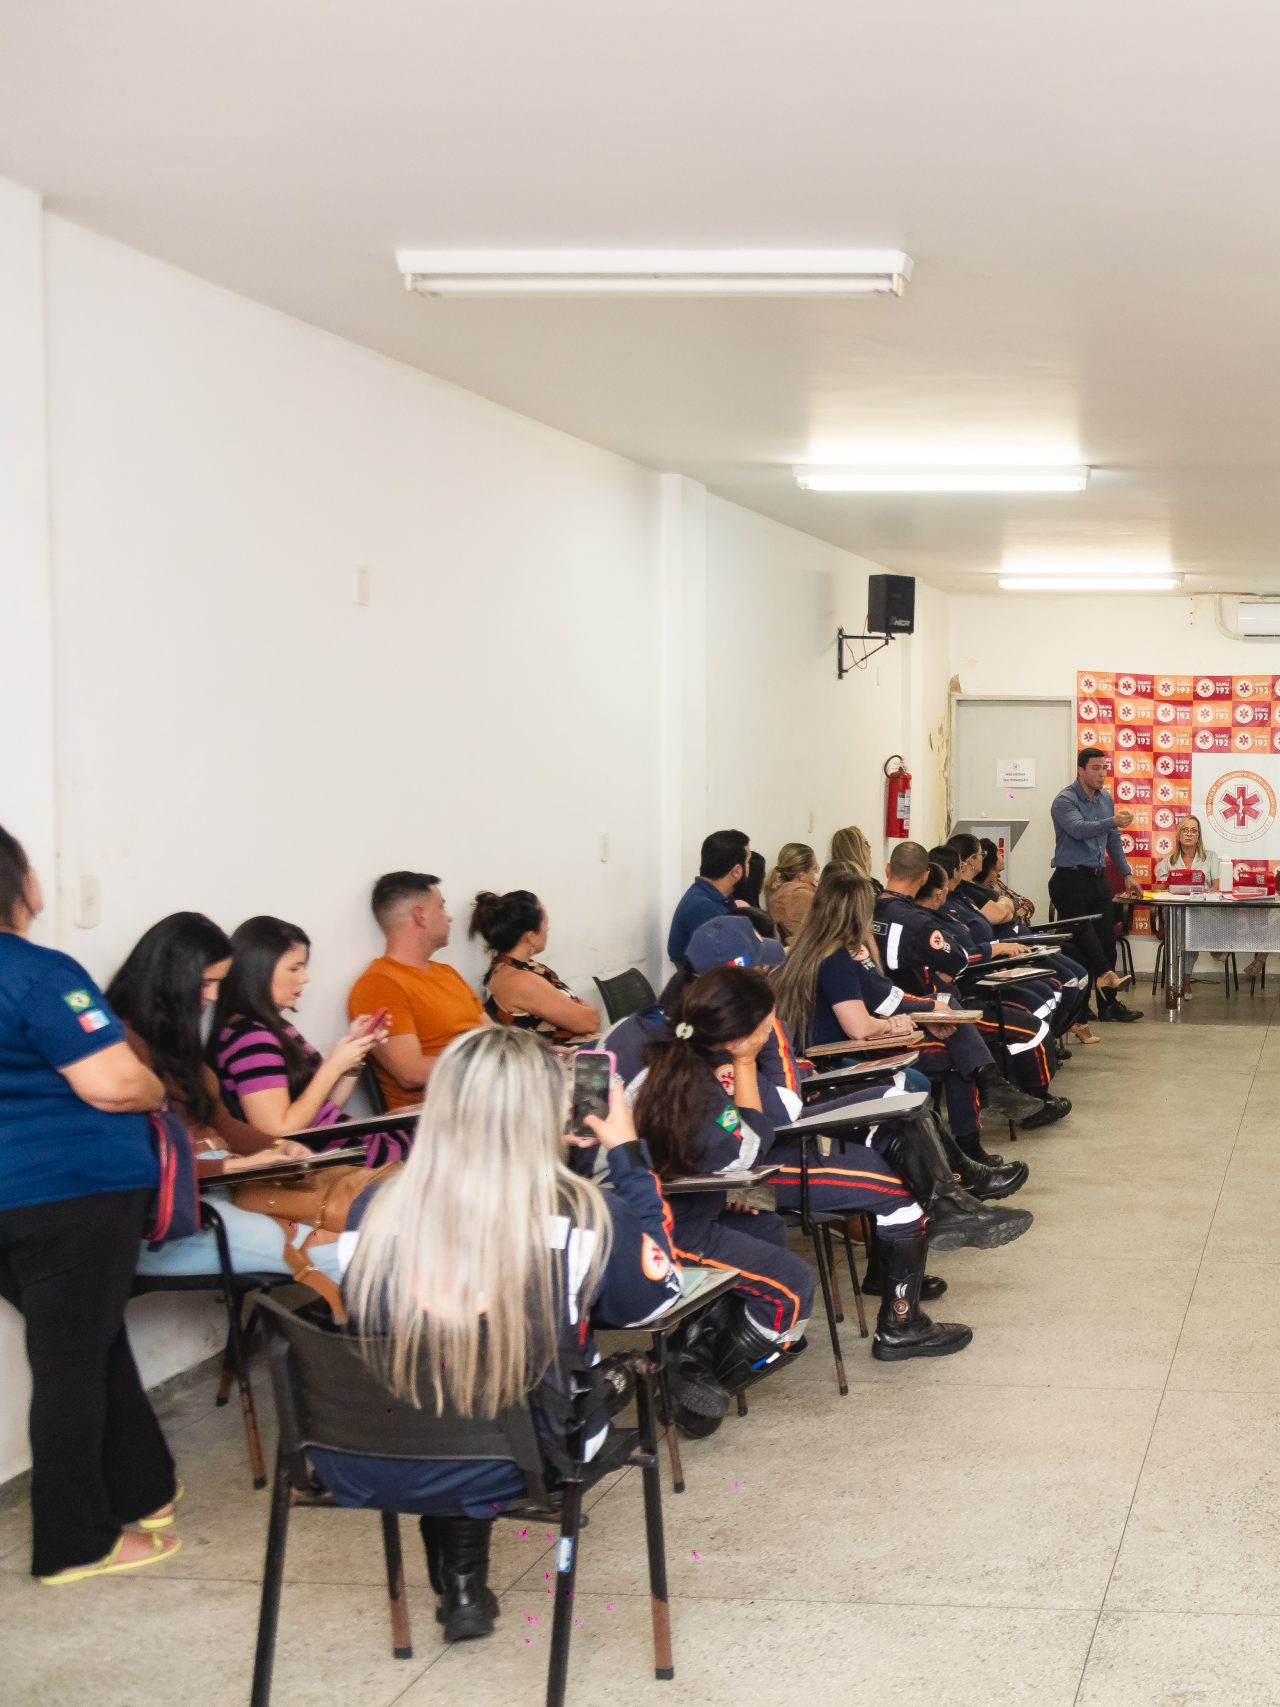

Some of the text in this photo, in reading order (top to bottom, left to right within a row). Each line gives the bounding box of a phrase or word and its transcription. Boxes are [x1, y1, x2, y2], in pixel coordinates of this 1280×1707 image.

[1099, 683, 1113, 691] 192
[1216, 686, 1230, 694] 192
[1255, 686, 1268, 694] 192
[1099, 709, 1112, 717] 192
[1137, 710, 1151, 718] 192
[1216, 712, 1229, 720] 192
[1099, 736, 1112, 744] 192
[1137, 737, 1150, 745] 192
[1215, 738, 1229, 746] 192
[1254, 739, 1268, 747] 192
[1175, 765, 1189, 773] 192
[1135, 843, 1149, 851] 192
